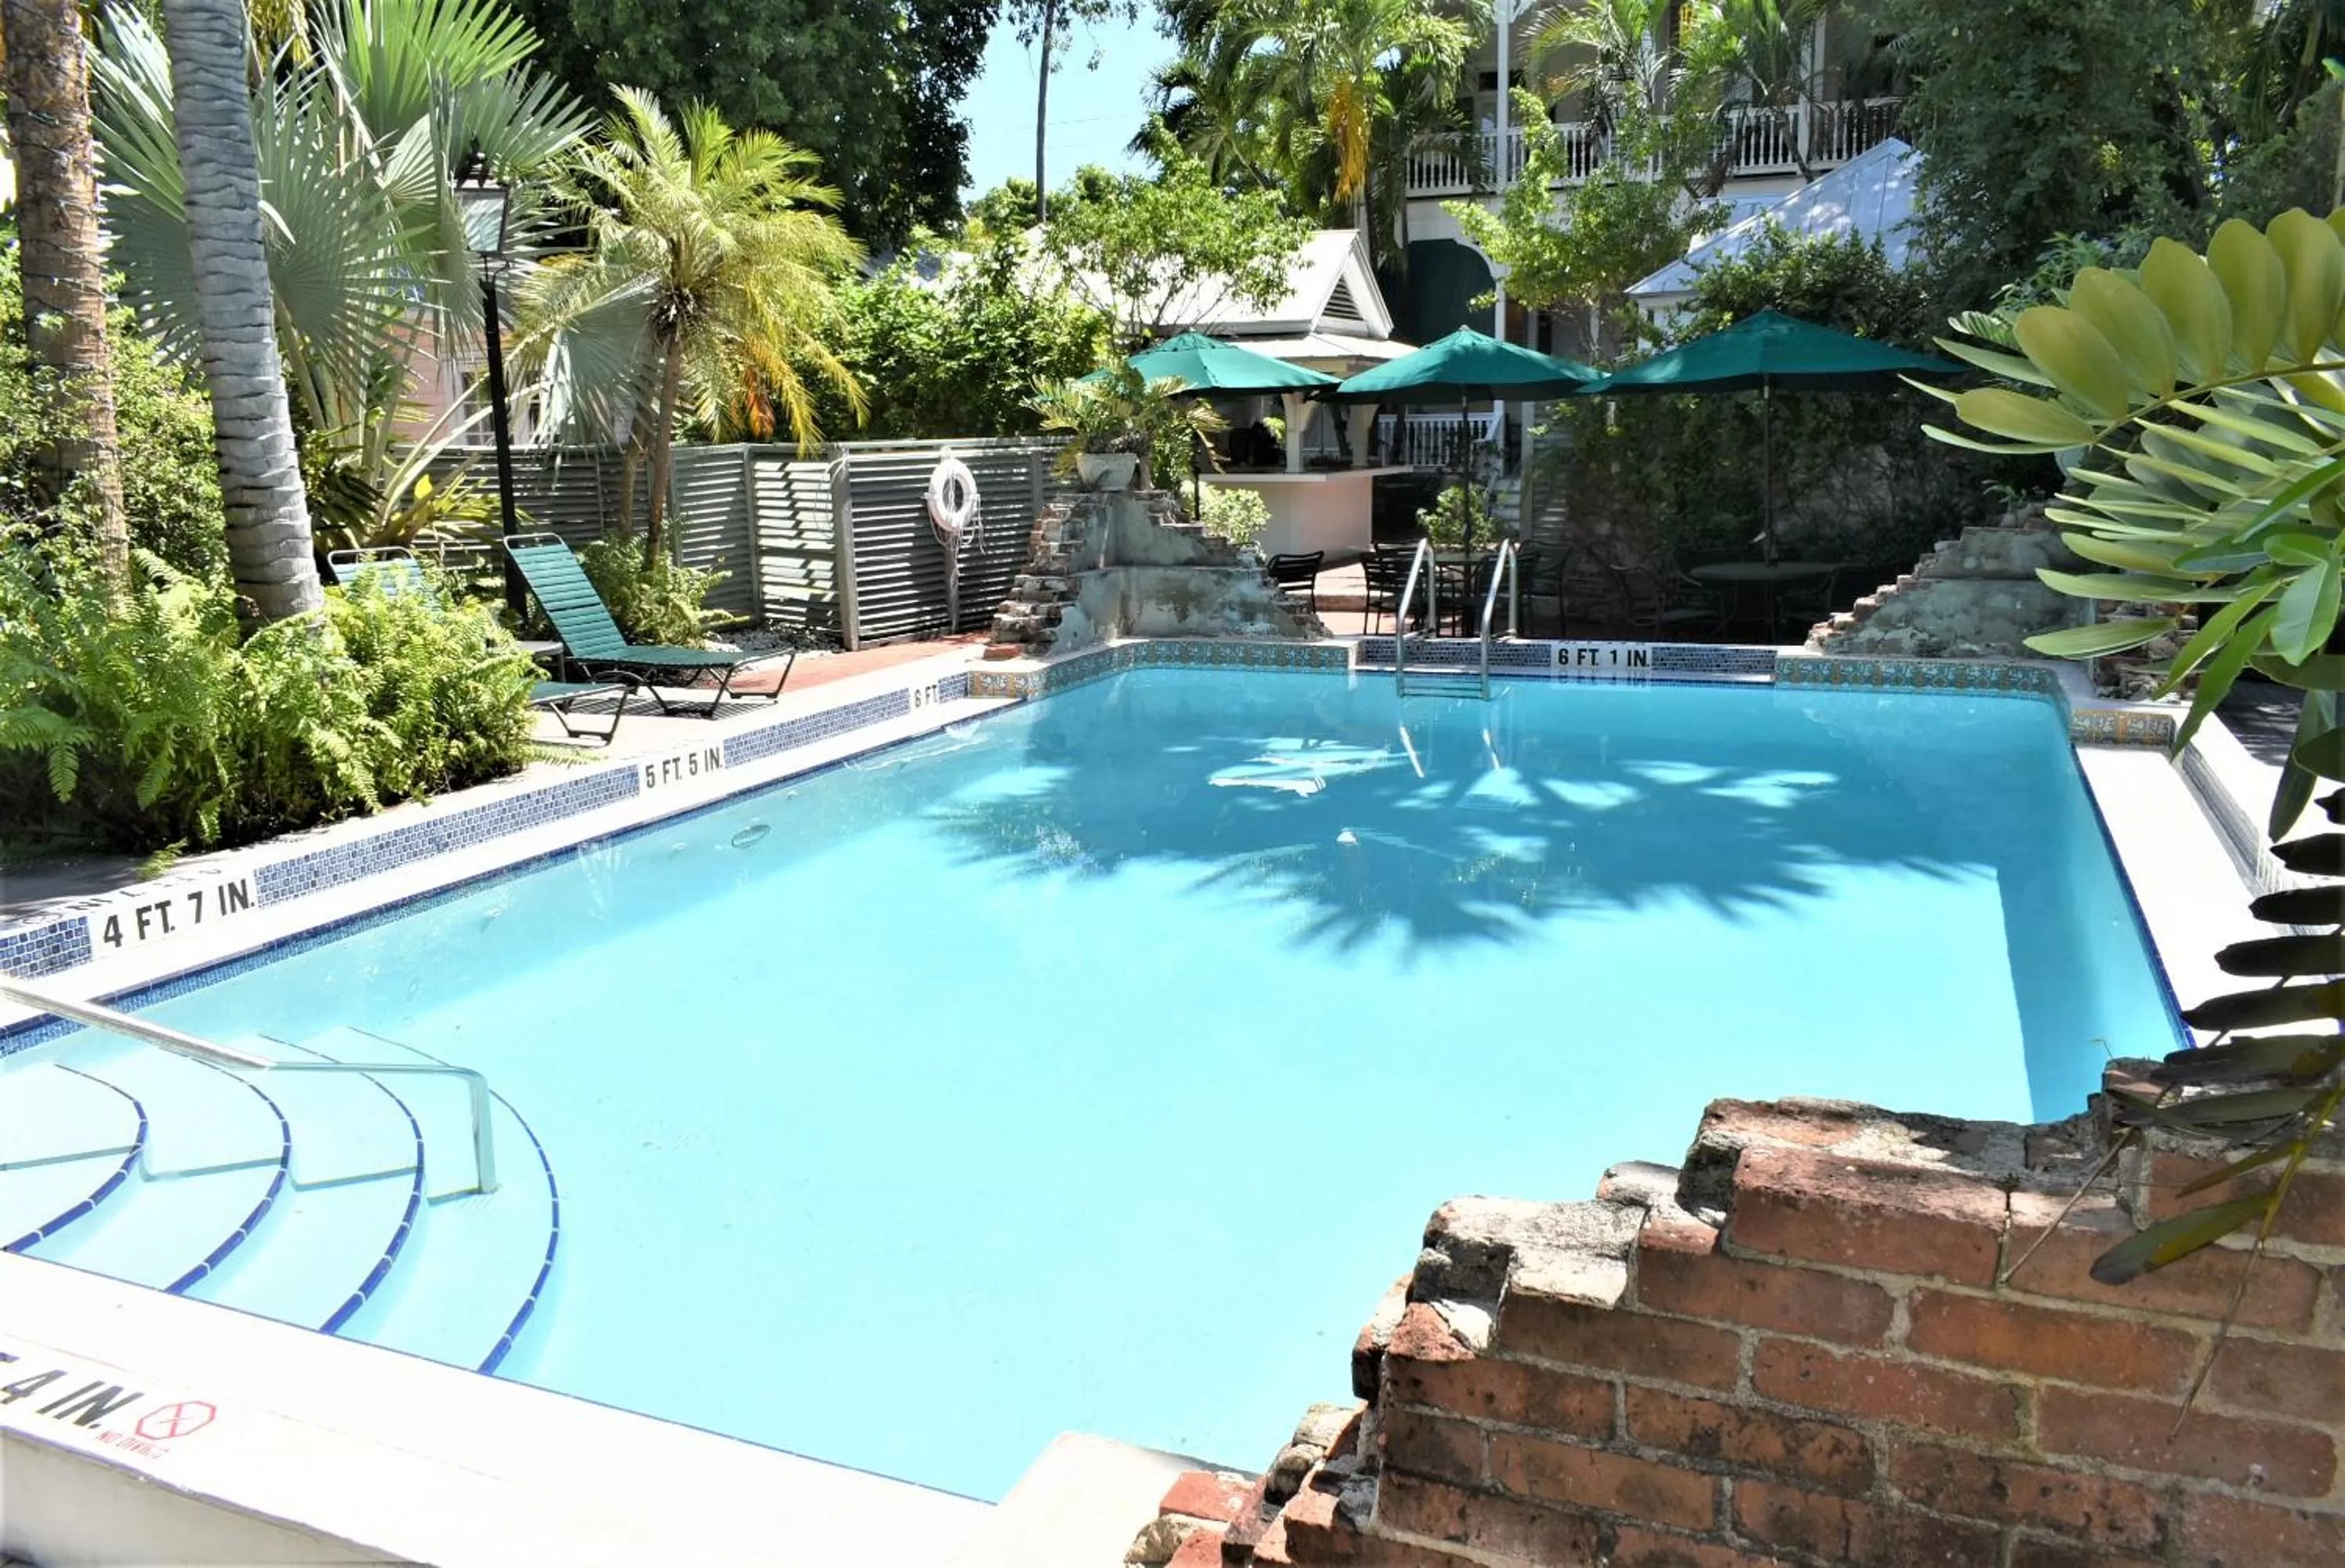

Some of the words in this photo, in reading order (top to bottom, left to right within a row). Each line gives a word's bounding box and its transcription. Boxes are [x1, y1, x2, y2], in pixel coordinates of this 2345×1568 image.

[1558, 648, 1569, 666] 6
[1577, 648, 1599, 666] FT.
[1610, 649, 1617, 665] 1
[1627, 650, 1650, 667] IN.
[914, 689, 922, 708] 6
[645, 764, 655, 789] 5
[662, 757, 683, 785] FT.
[688, 752, 698, 776] 5
[704, 746, 723, 773] IN.
[103, 914, 123, 948] 4
[136, 899, 176, 941] FT.
[187, 891, 204, 924] 7
[218, 878, 256, 916] IN.
[0, 1369, 69, 1405] 4
[34, 1380, 145, 1429] IN.
